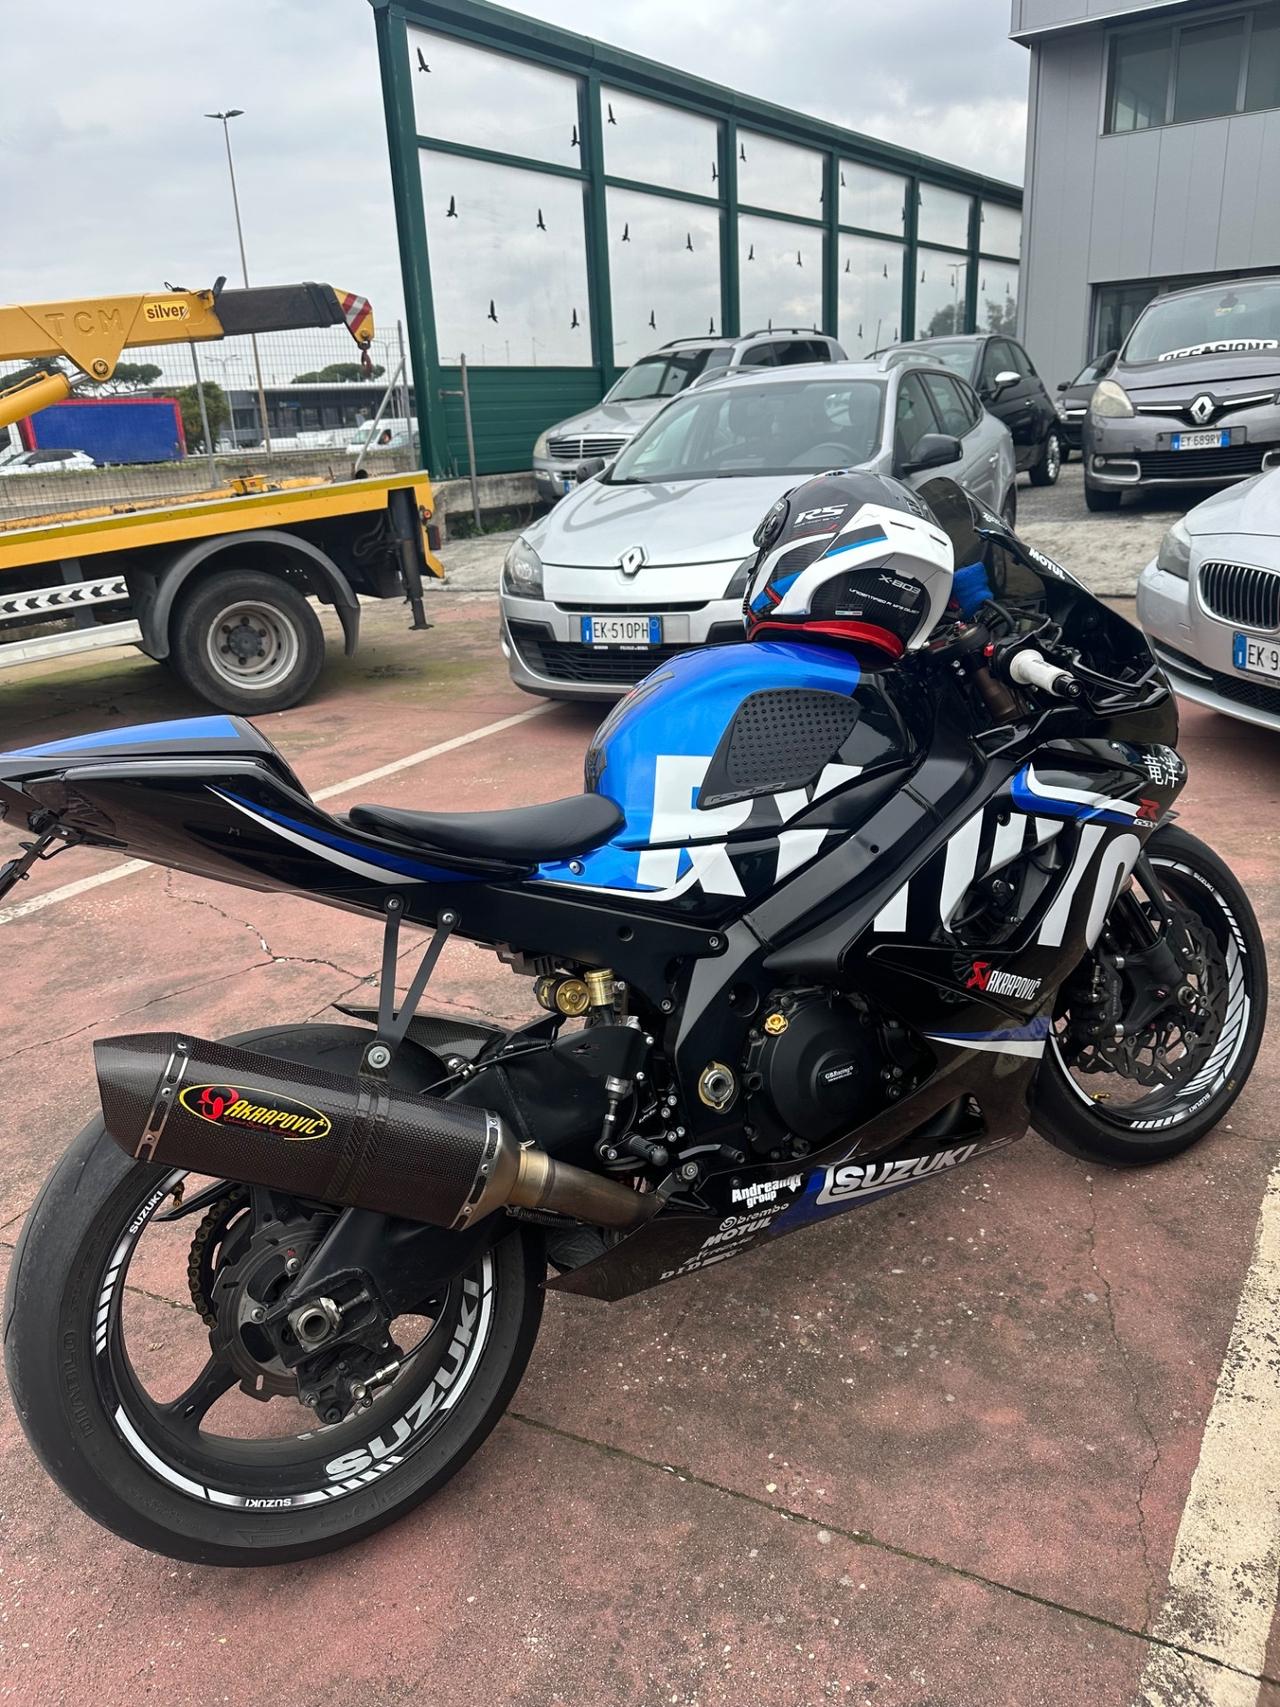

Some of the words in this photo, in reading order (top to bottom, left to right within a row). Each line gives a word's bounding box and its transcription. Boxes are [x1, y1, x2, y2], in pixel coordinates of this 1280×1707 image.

[45, 308, 125, 339] TCM
[146, 303, 185, 320] silver
[794, 504, 848, 525] RS
[1029, 547, 1066, 580] MOTUL
[1248, 643, 1265, 668] EK
[834, 1143, 978, 1195] SUZUKI
[129, 1190, 164, 1235] SUZUKI
[747, 1190, 777, 1208] group
[738, 1202, 790, 1225] brembo
[701, 1217, 773, 1249] MOTUL
[324, 1278, 480, 1482] SUZUKI
[244, 1498, 292, 1508] SUZUKI
